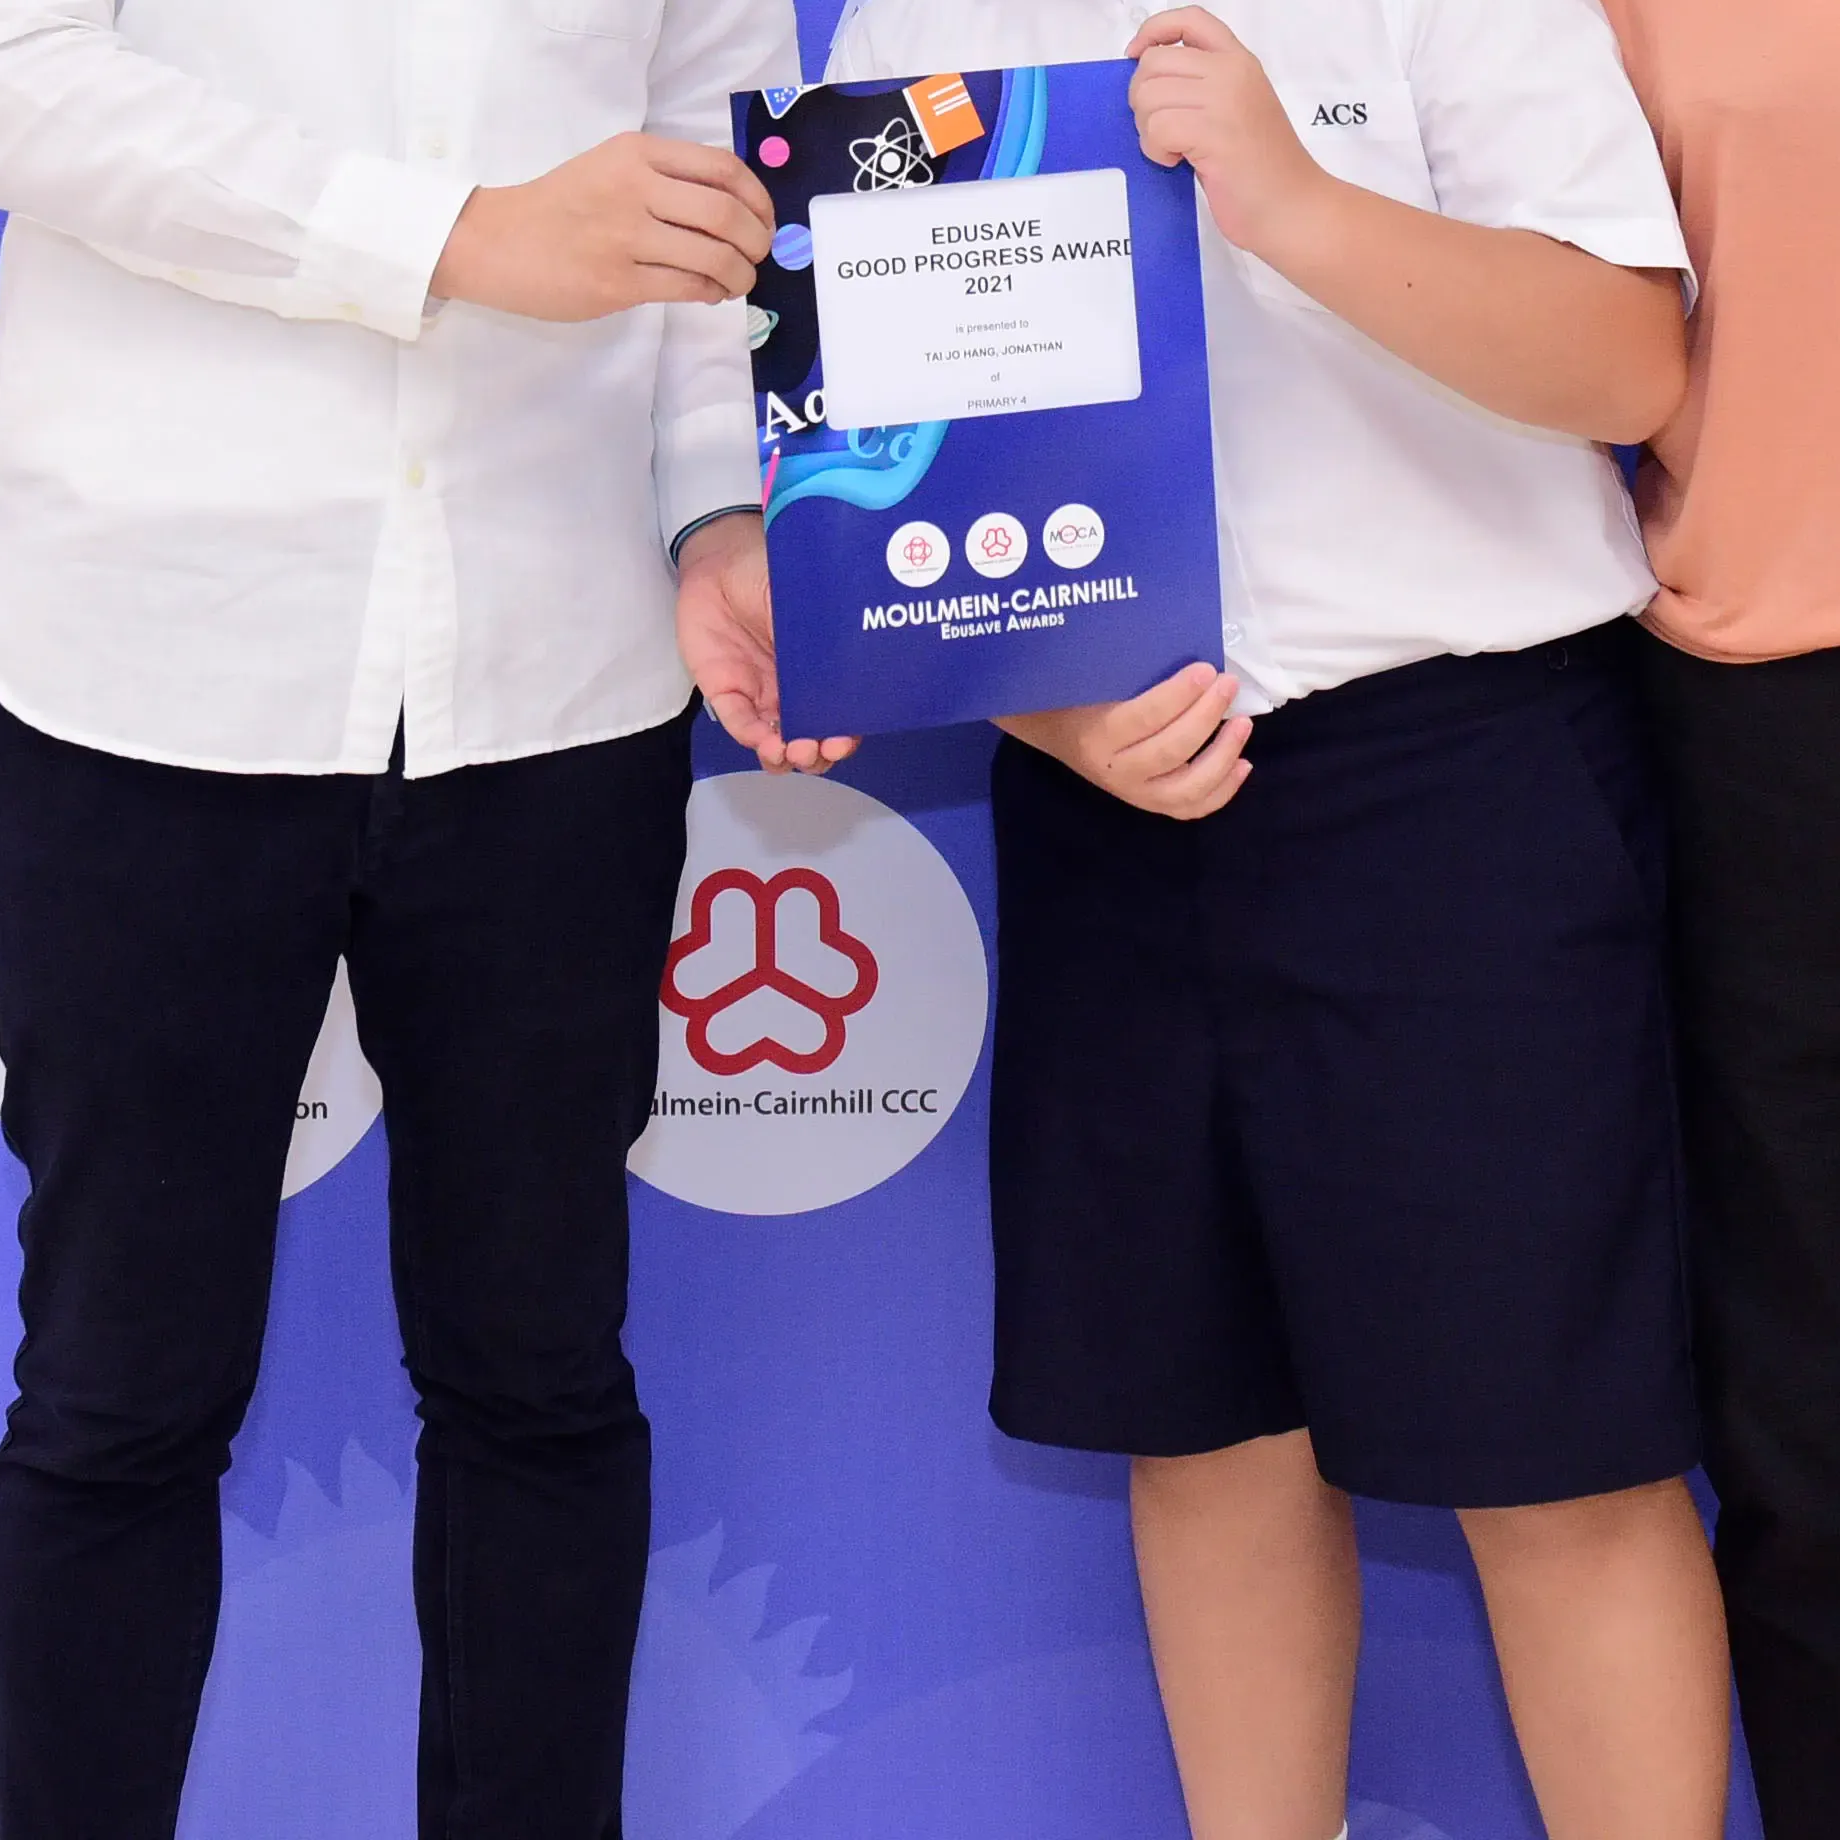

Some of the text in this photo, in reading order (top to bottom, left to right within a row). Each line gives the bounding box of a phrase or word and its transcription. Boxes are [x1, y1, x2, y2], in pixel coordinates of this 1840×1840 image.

[1311, 103, 1368, 126] ACS
[931, 219, 1042, 245] EDUSAVE
[837, 257, 907, 279] GOOD
[914, 245, 1044, 272] PROGRESS
[964, 274, 1013, 295] 2021
[955, 318, 1029, 335] is presented to
[945, 350, 961, 361] JO
[963, 347, 999, 360] HANG,
[1001, 340, 1063, 357] JONATHAN
[990, 371, 1001, 383] of
[967, 395, 1027, 410] PRIMARY 4
[862, 575, 1140, 632] MOULMEIN-CAIRNHILL
[941, 612, 1066, 641] EDUSAVE AWARDS
[881, 1089, 938, 1114] CCC
